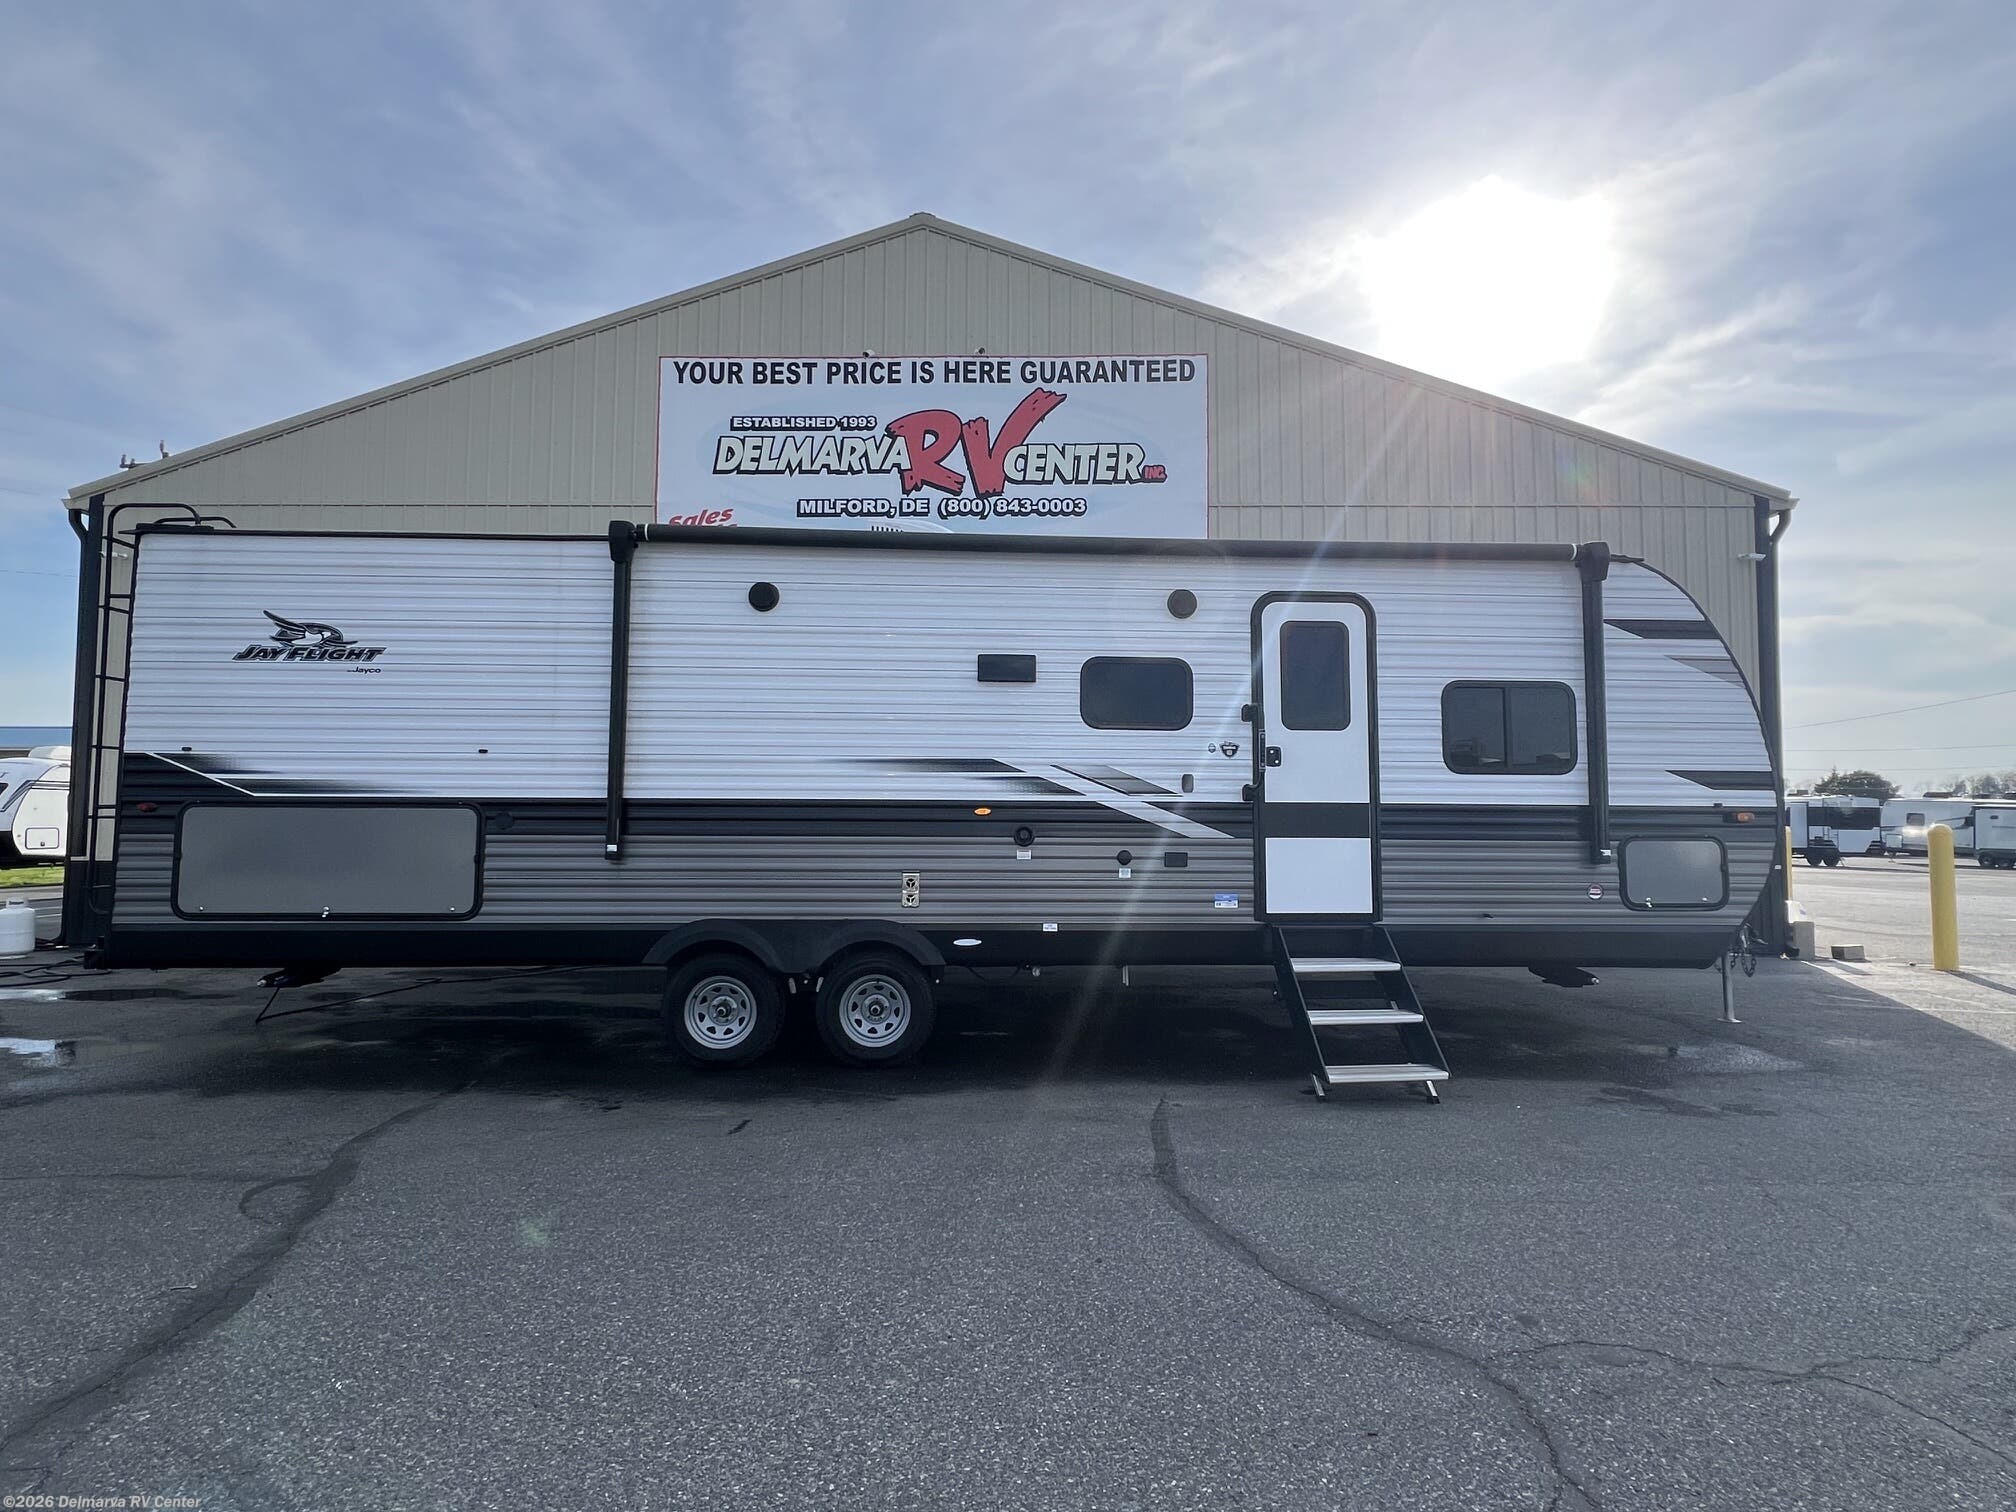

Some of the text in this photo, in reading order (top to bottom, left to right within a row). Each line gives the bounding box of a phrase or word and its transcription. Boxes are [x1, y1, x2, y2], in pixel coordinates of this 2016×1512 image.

[673, 359, 1196, 384] YOUR BEST PRICE IS HERE GUARANTEED
[731, 416, 877, 429] ESTABLISHED 1993
[714, 436, 912, 475] DELMARVA
[886, 387, 1067, 498] RV
[1003, 444, 1144, 484] CENTER
[798, 498, 1087, 519] MILFORD, DE (800) 843-0003
[232, 645, 387, 662] JAY FLIGHT
